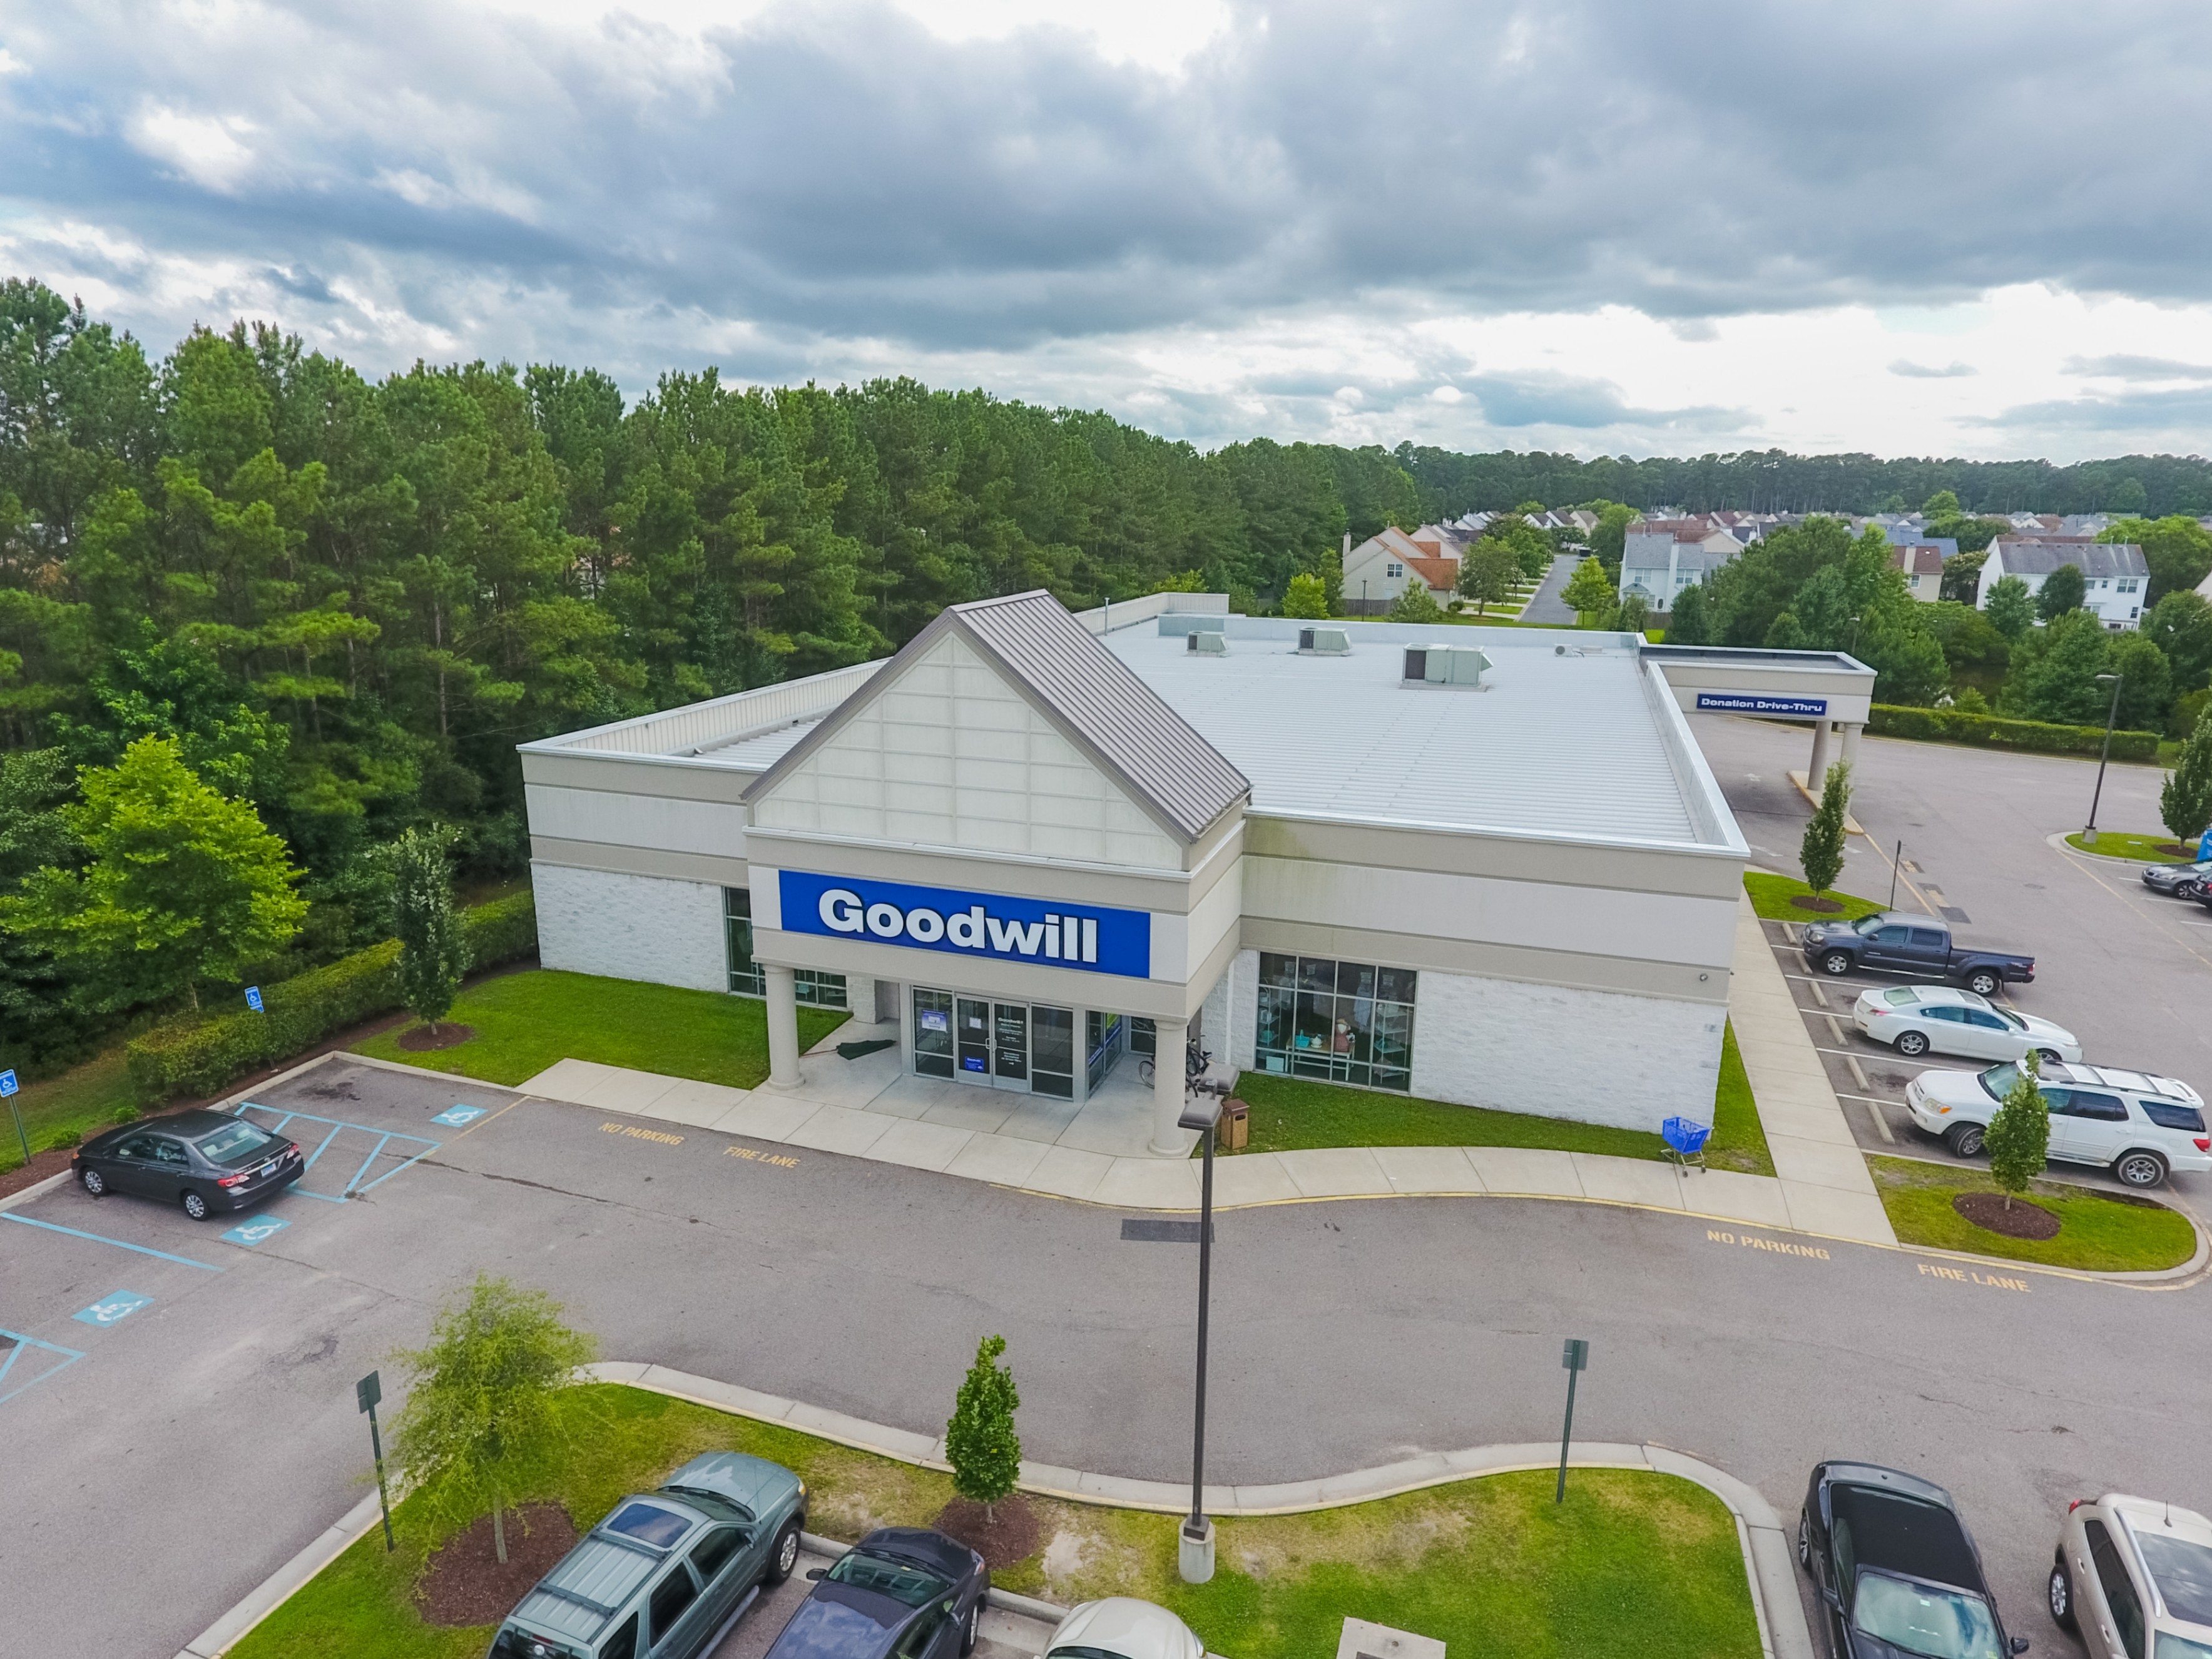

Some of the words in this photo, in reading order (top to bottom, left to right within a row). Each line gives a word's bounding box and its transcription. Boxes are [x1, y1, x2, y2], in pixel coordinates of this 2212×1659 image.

[1701, 698, 1754, 708] Donation
[1756, 701, 1822, 712] Drive-Thru
[818, 889, 1097, 963] Goodwill
[598, 1122, 623, 1134] NO
[620, 1126, 685, 1146] PARKING
[723, 1146, 761, 1160] FIRE
[758, 1152, 801, 1169] LANE
[1706, 1230, 1735, 1244] NO
[1740, 1235, 1831, 1261] PARKING
[1917, 1264, 1968, 1282] FIRE
[1971, 1272, 2032, 1293] LANE
